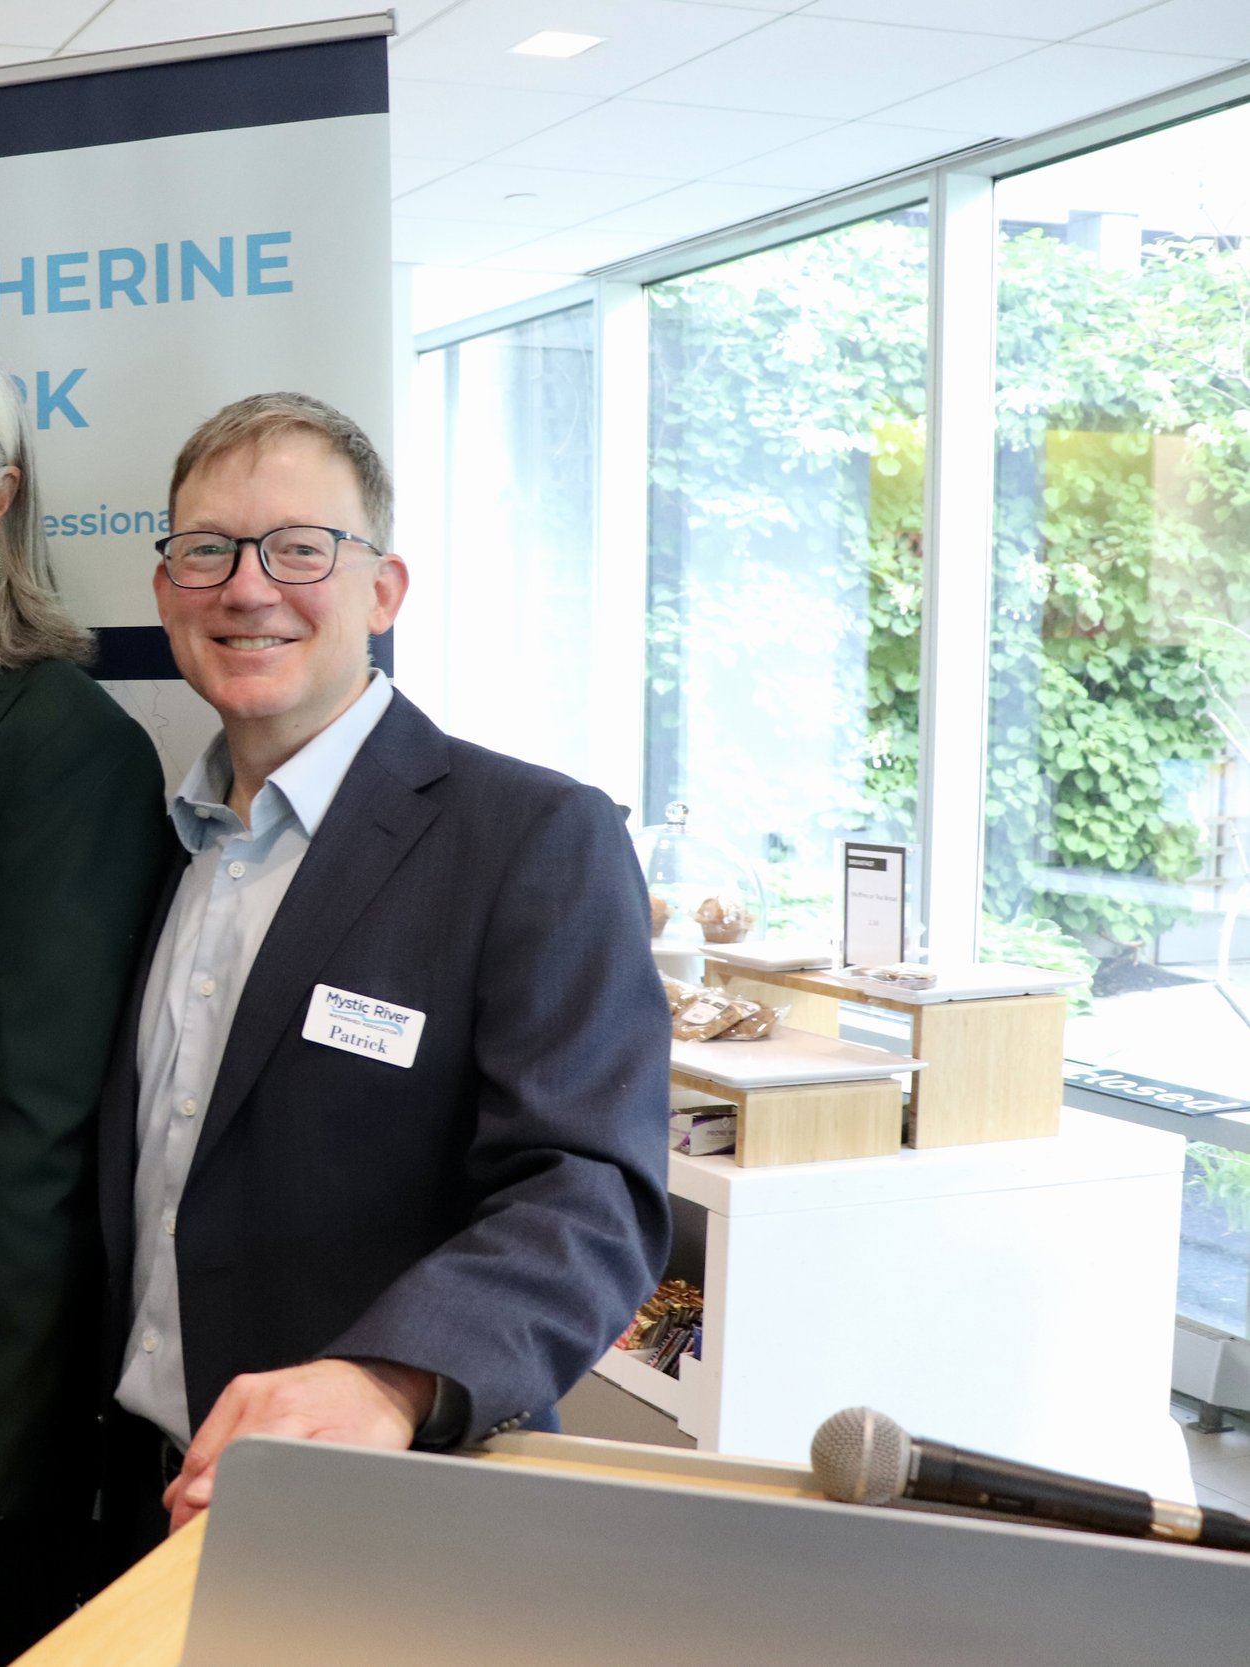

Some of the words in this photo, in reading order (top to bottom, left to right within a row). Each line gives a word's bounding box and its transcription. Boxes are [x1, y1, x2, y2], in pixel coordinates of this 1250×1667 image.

[325, 991, 370, 1014] Mystic
[373, 1004, 411, 1025] River
[328, 1024, 388, 1054] Patrick
